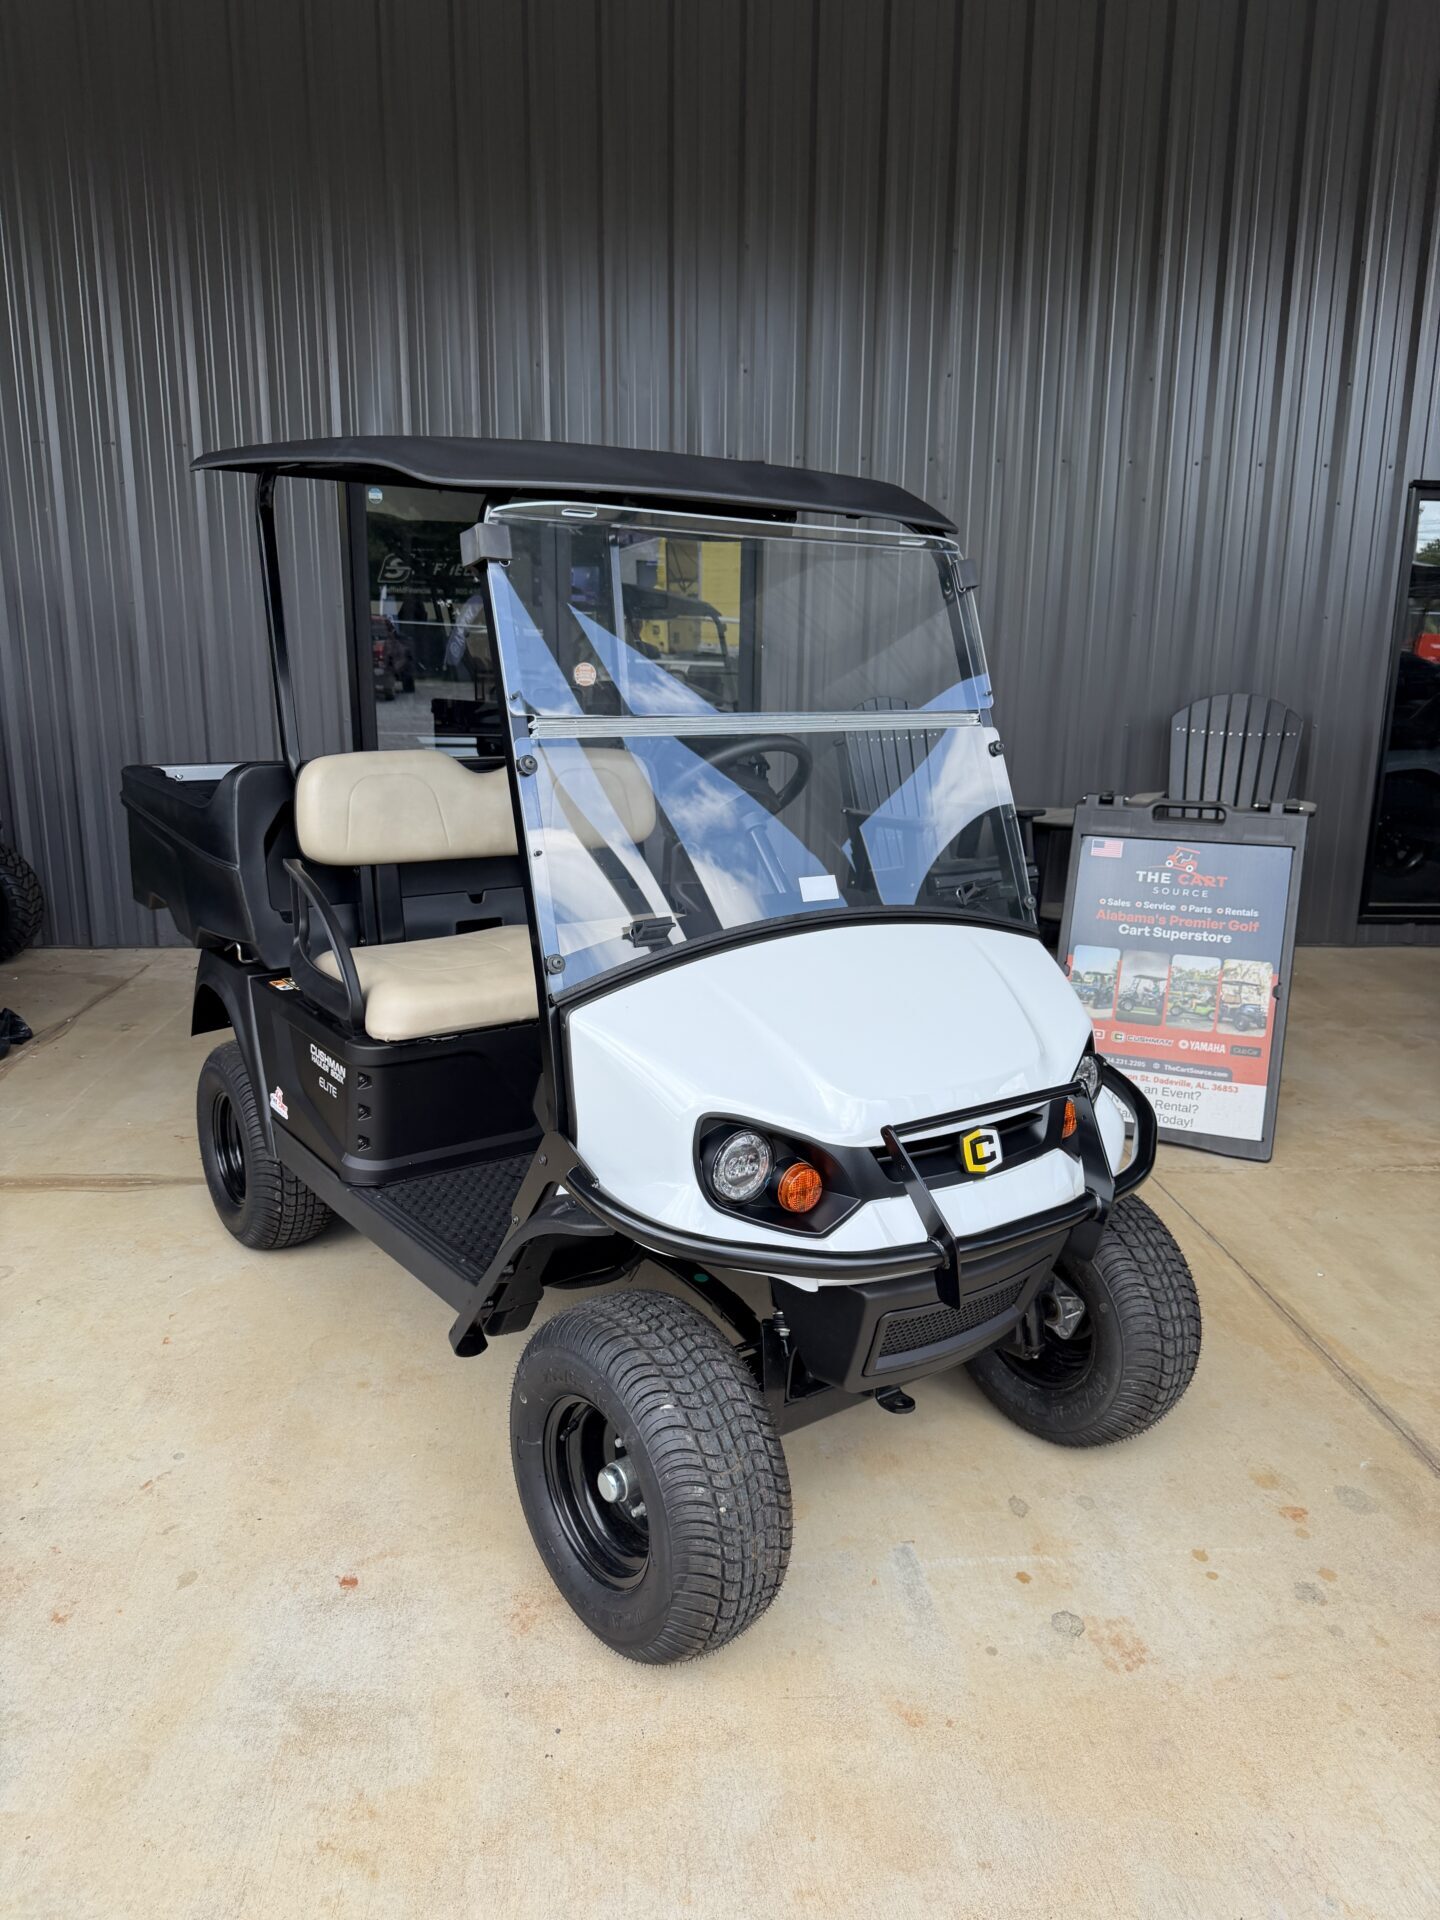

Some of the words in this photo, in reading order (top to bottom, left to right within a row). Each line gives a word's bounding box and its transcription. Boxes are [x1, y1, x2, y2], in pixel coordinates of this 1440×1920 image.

[1136, 871, 1172, 884] THE
[1178, 874, 1228, 888] CART
[1152, 887, 1208, 897] SOURCE
[1107, 898, 1131, 907] Sales
[1144, 901, 1176, 911] Service
[1189, 905, 1212, 914] Parts
[1225, 908, 1259, 917] Rentals
[1096, 910, 1166, 925] Alabama's
[1170, 915, 1226, 929] Premier
[1228, 920, 1260, 932] Golf
[1119, 924, 1151, 936] Cart
[1153, 927, 1232, 943] Superstore
[1127, 1035, 1174, 1047] CUSHMAN
[1189, 1041, 1226, 1053] YAMAHA
[310, 1043, 346, 1078] CUSHMAN
[1164, 1064, 1229, 1077] TheCartSource.com
[1153, 1077, 1194, 1089] Dadeville,
[1195, 1082, 1209, 1090] AL.
[1211, 1084, 1239, 1093] 36853
[1144, 1086, 1158, 1095] an
[1161, 1087, 1201, 1100] Event?
[1155, 1100, 1199, 1114] Rental?
[1157, 1114, 1194, 1127] Today!
[970, 1134, 997, 1165] C
